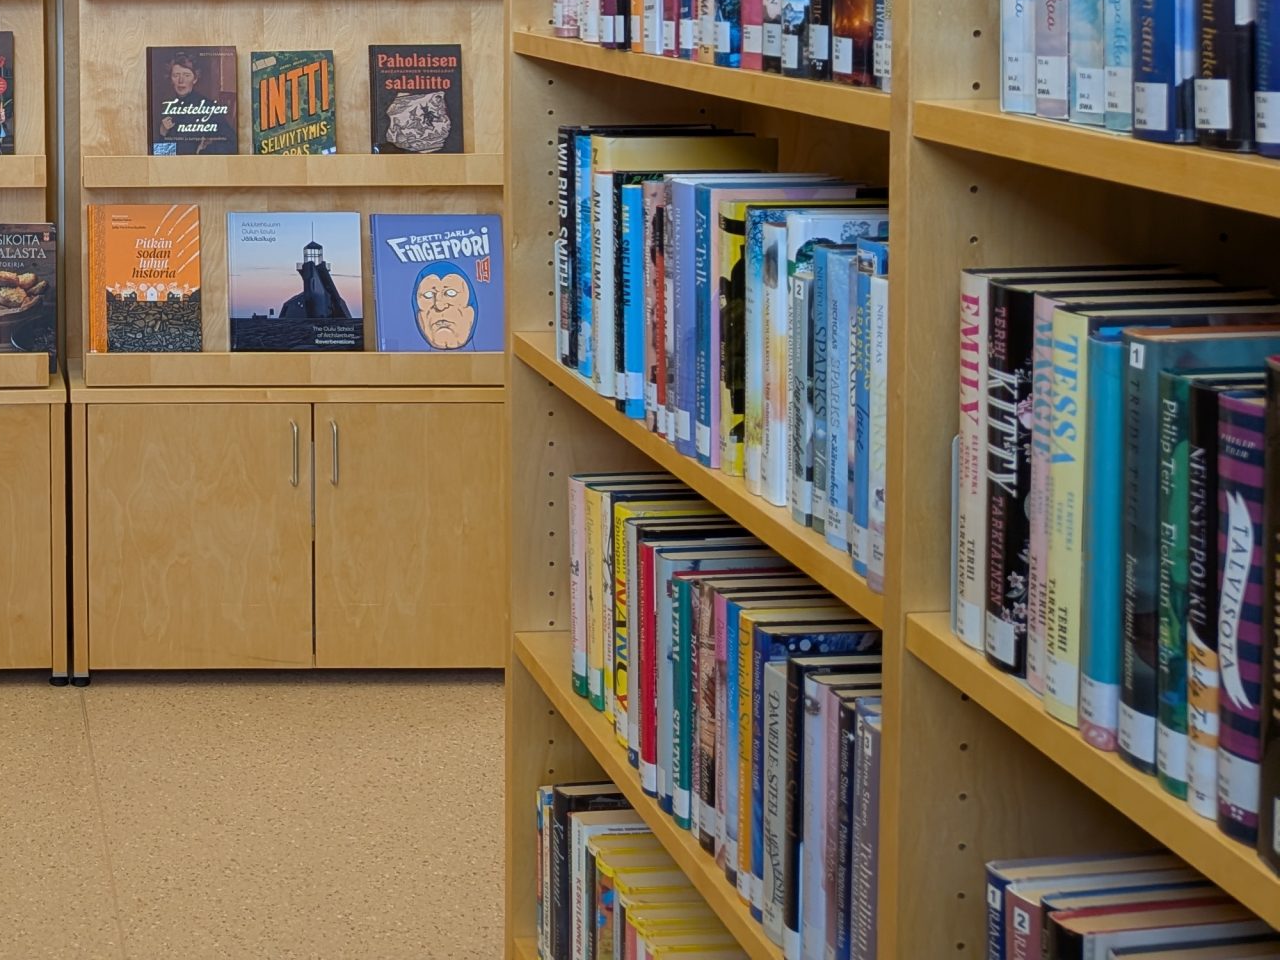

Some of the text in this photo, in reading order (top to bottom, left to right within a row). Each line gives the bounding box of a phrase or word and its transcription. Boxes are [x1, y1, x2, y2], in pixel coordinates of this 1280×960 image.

[377, 53, 458, 68] Paholaisen
[1141, 15, 1157, 74] saari
[161, 97, 229, 123] Taistelujen
[260, 59, 329, 131] INTTI
[384, 74, 452, 90] salaliitto
[176, 118, 219, 132] nainen
[261, 121, 332, 154] SELVIYTYMIS-
[135, 237, 173, 249] Pitkän
[409, 228, 476, 244] PERTTI JARLA
[557, 142, 570, 288] WILBUR SMITH
[131, 267, 177, 279] historia
[135, 248, 171, 259] sodan
[139, 258, 169, 271] lyhyt
[475, 256, 491, 283] 19
[592, 190, 603, 302] ANJA SNELLMAN
[695, 209, 709, 289] Ex Talk
[875, 303, 885, 364] NICHOLAS
[960, 292, 981, 426] EMILY
[815, 325, 828, 418] SPARKS
[830, 298, 841, 429] NICHOLAS SPARKS
[1052, 334, 1080, 467] TESSA
[987, 366, 1019, 607] KITTY TARKIAINEN
[1159, 396, 1180, 609] Philip Teir Elokuun
[615, 516, 624, 574] Spungen
[958, 513, 968, 598] TARKIAINEN
[966, 538, 976, 582] TERHI
[1221, 524, 1250, 670] TALVISOTA
[615, 576, 628, 715] NANCY
[1057, 605, 1068, 654] TERHI
